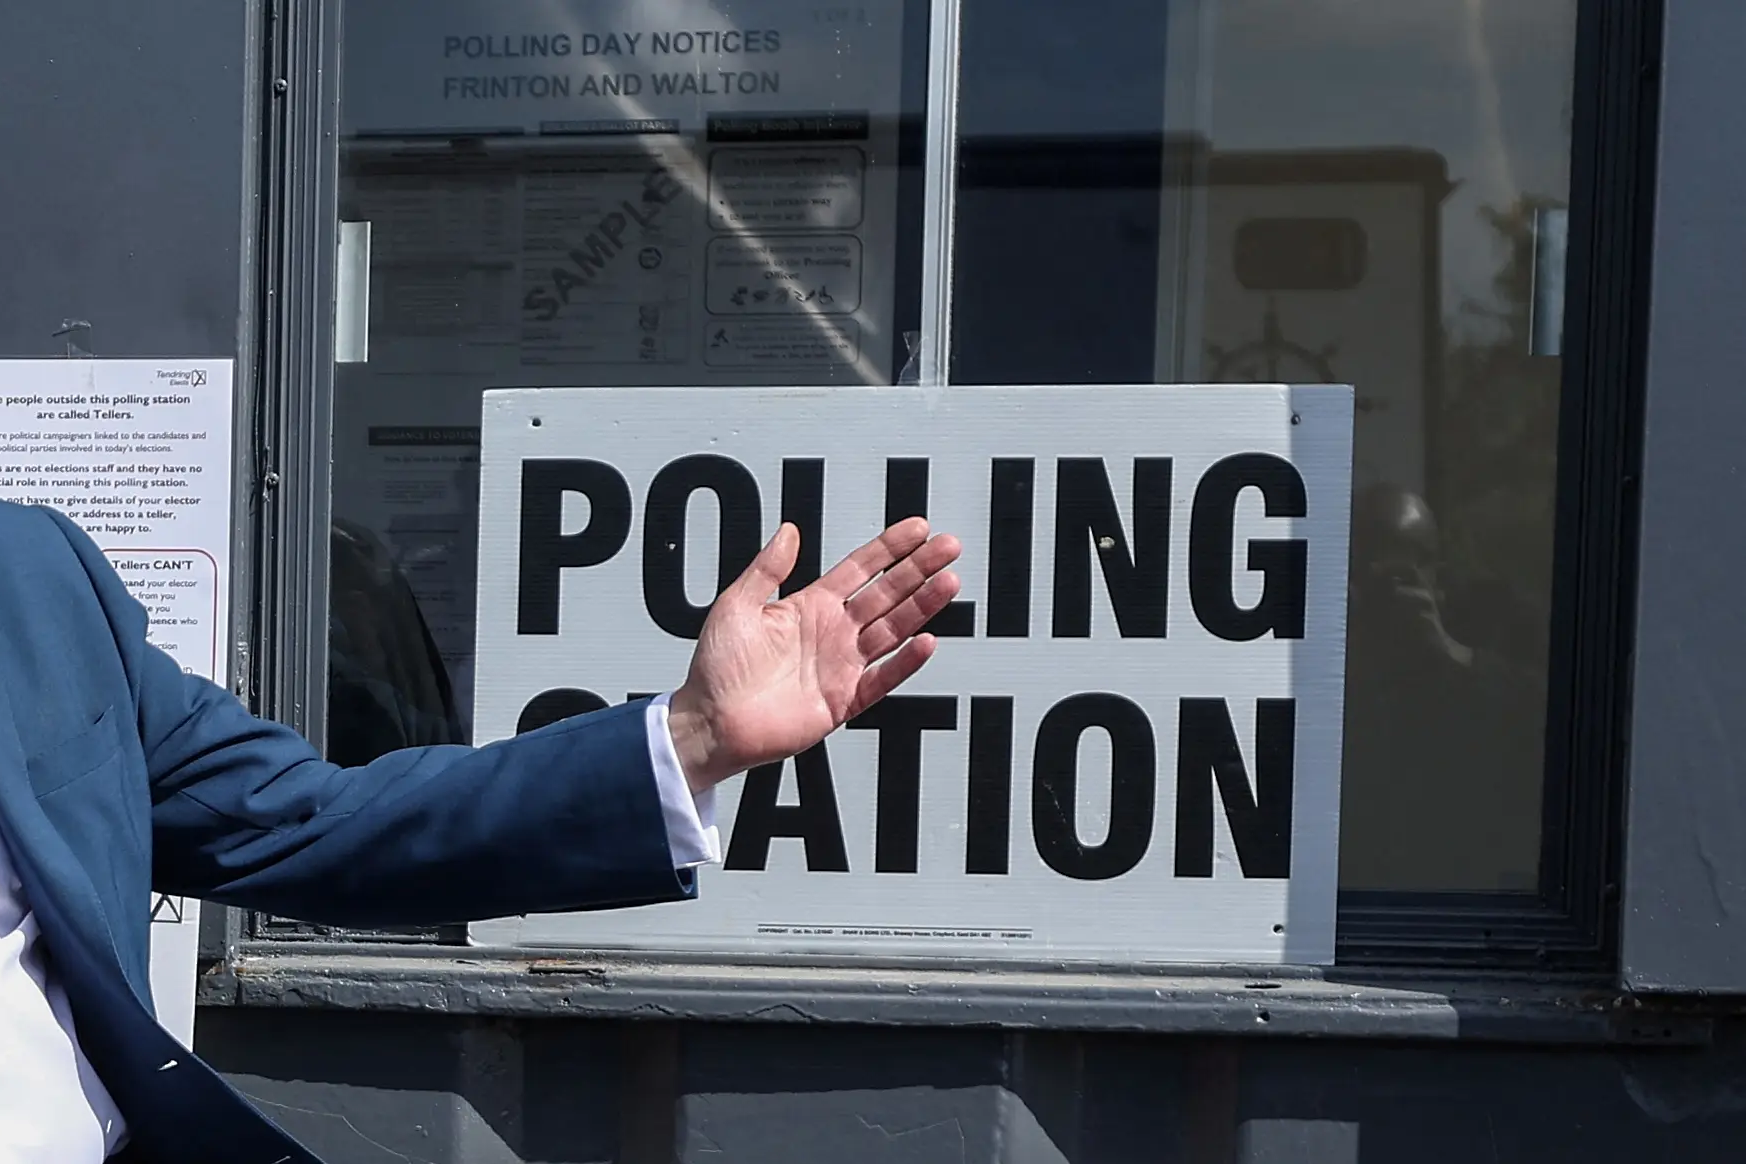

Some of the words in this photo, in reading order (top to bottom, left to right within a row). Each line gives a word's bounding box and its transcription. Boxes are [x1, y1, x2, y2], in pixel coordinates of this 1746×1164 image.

[444, 35, 571, 58] POLLING
[582, 33, 641, 56] DAY
[652, 30, 780, 54] NOTICES
[444, 76, 570, 99] FRINTON
[579, 73, 641, 96] AND
[652, 71, 780, 94] WALTON
[523, 167, 684, 321] SAMPLE
[157, 371, 190, 380] Tendring
[7, 395, 42, 407] people
[47, 395, 86, 404] outside
[90, 395, 109, 404] this
[113, 395, 149, 407] polling
[153, 395, 190, 404] station
[58, 410, 89, 419] called
[93, 410, 134, 419] Tellers.
[10, 432, 41, 441] political
[43, 433, 92, 442] campaigners
[95, 432, 118, 440] linked
[132, 432, 145, 440] the
[147, 432, 189, 440] candidates
[192, 432, 206, 440] and
[30, 445, 57, 454] parties
[59, 444, 93, 452] involved
[105, 445, 133, 454] today's
[136, 444, 173, 452] elections.
[25, 465, 41, 473] not
[45, 464, 89, 473] elections
[92, 464, 114, 473] staff
[117, 464, 134, 473] and
[138, 464, 160, 475] they
[163, 464, 186, 473] have
[17, 478, 36, 487] role
[39, 479, 49, 487] in
[52, 479, 90, 489] running
[93, 478, 111, 487] this
[114, 478, 148, 489] polling
[151, 479, 188, 487] station.
[27, 496, 50, 505] have
[67, 496, 87, 507] give
[90, 496, 122, 505] details
[126, 496, 136, 505] of
[138, 498, 161, 507] your
[165, 496, 200, 505] elector
[83, 510, 120, 518] address
[146, 510, 176, 520] teller,
[105, 523, 136, 534] happy
[112, 561, 150, 570] Tellers
[154, 561, 193, 570] CAN'T
[147, 581, 166, 590] your
[169, 579, 197, 587] elector
[138, 592, 158, 600] from
[161, 593, 175, 602] you
[156, 606, 170, 614] you
[180, 617, 198, 625] who
[516, 687, 1296, 880] ATION
